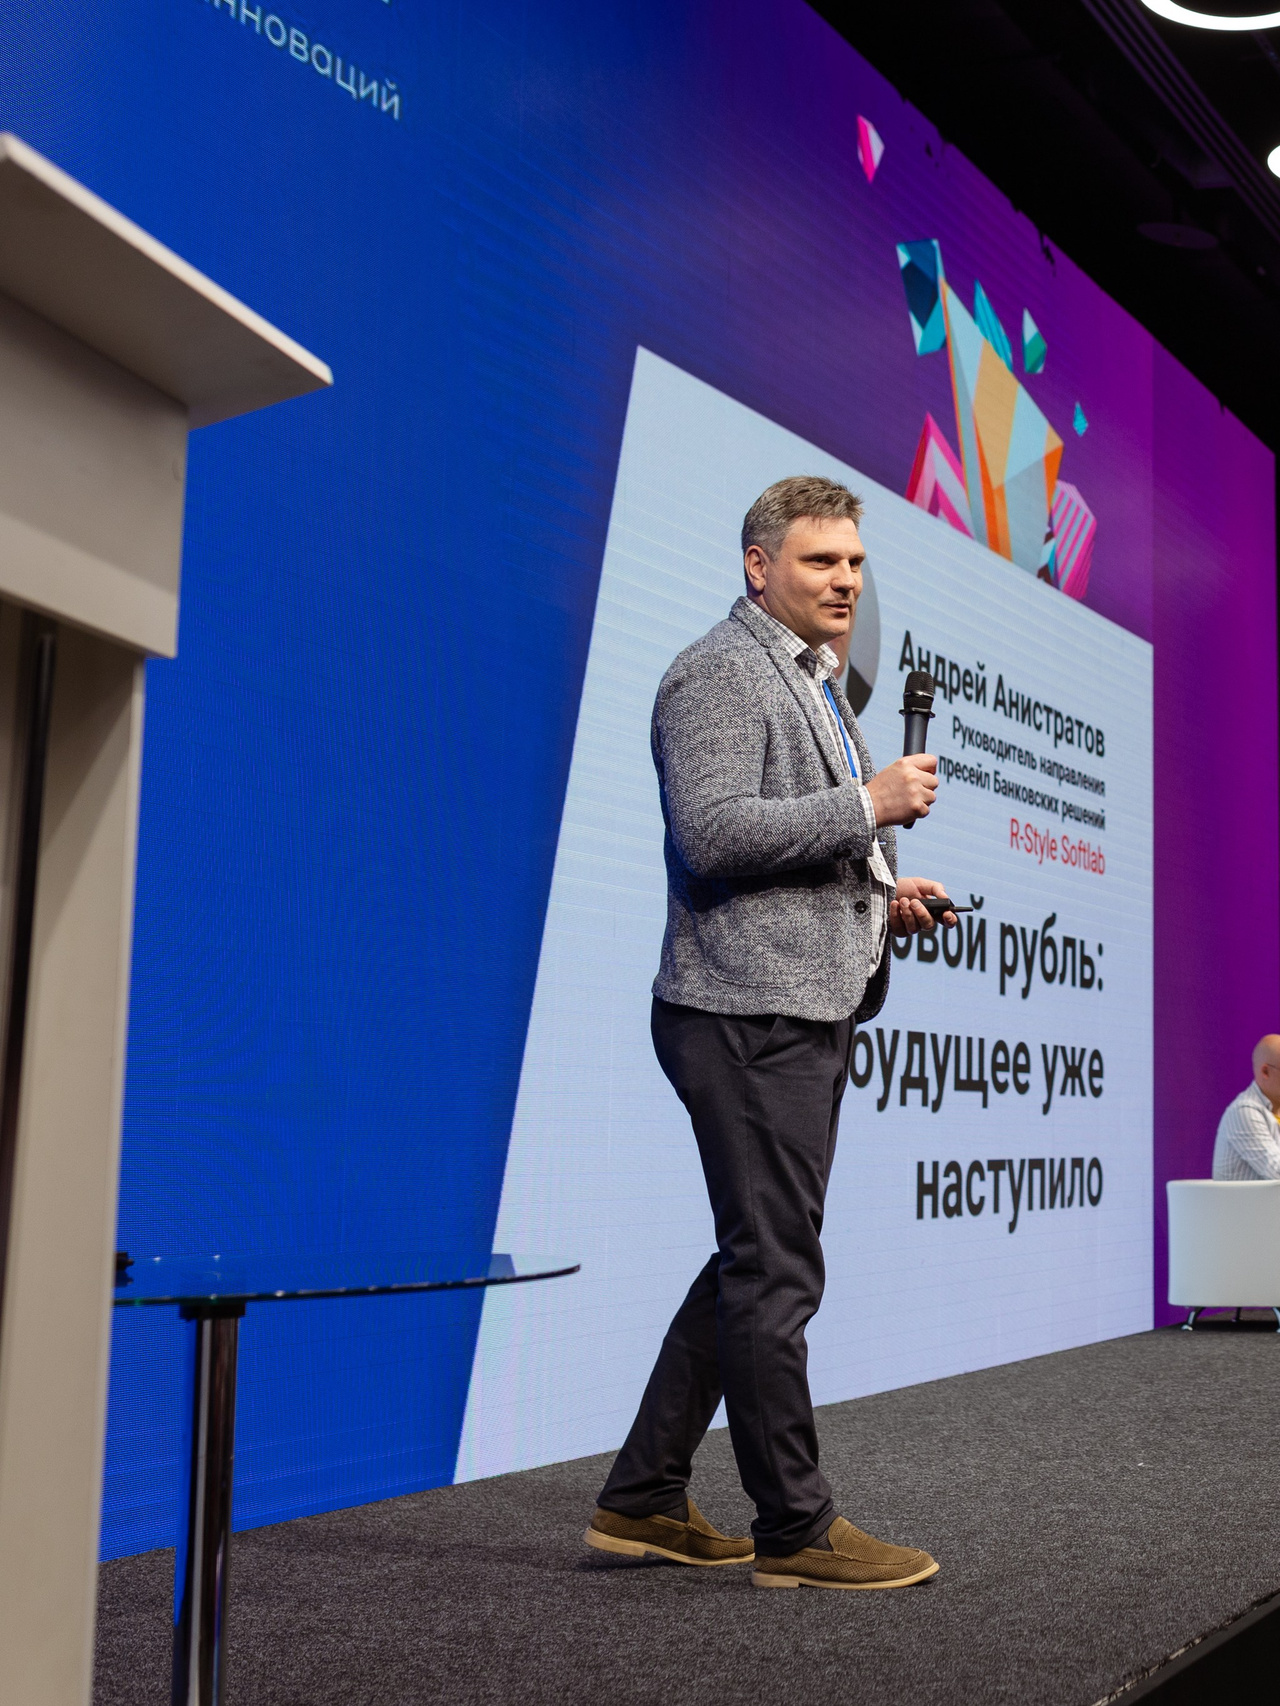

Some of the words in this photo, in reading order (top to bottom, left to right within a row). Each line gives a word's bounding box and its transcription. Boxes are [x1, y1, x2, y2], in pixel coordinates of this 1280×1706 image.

[205, 0, 400, 120] нноваций
[899, 629, 987, 708] Андрей
[993, 673, 1106, 757] Анистратов
[938, 755, 991, 792] пресейл
[993, 770, 1060, 814] Банковских
[1061, 799, 1106, 830] решений
[952, 715, 1038, 770] Руководитель
[1039, 754, 1106, 798] направления
[1010, 817, 1058, 865] R-Style
[1060, 834, 1106, 875] Softlab
[999, 912, 1104, 1000] рубль:
[1041, 1043, 1104, 1116] уже
[916, 1156, 1104, 1234] наступило
